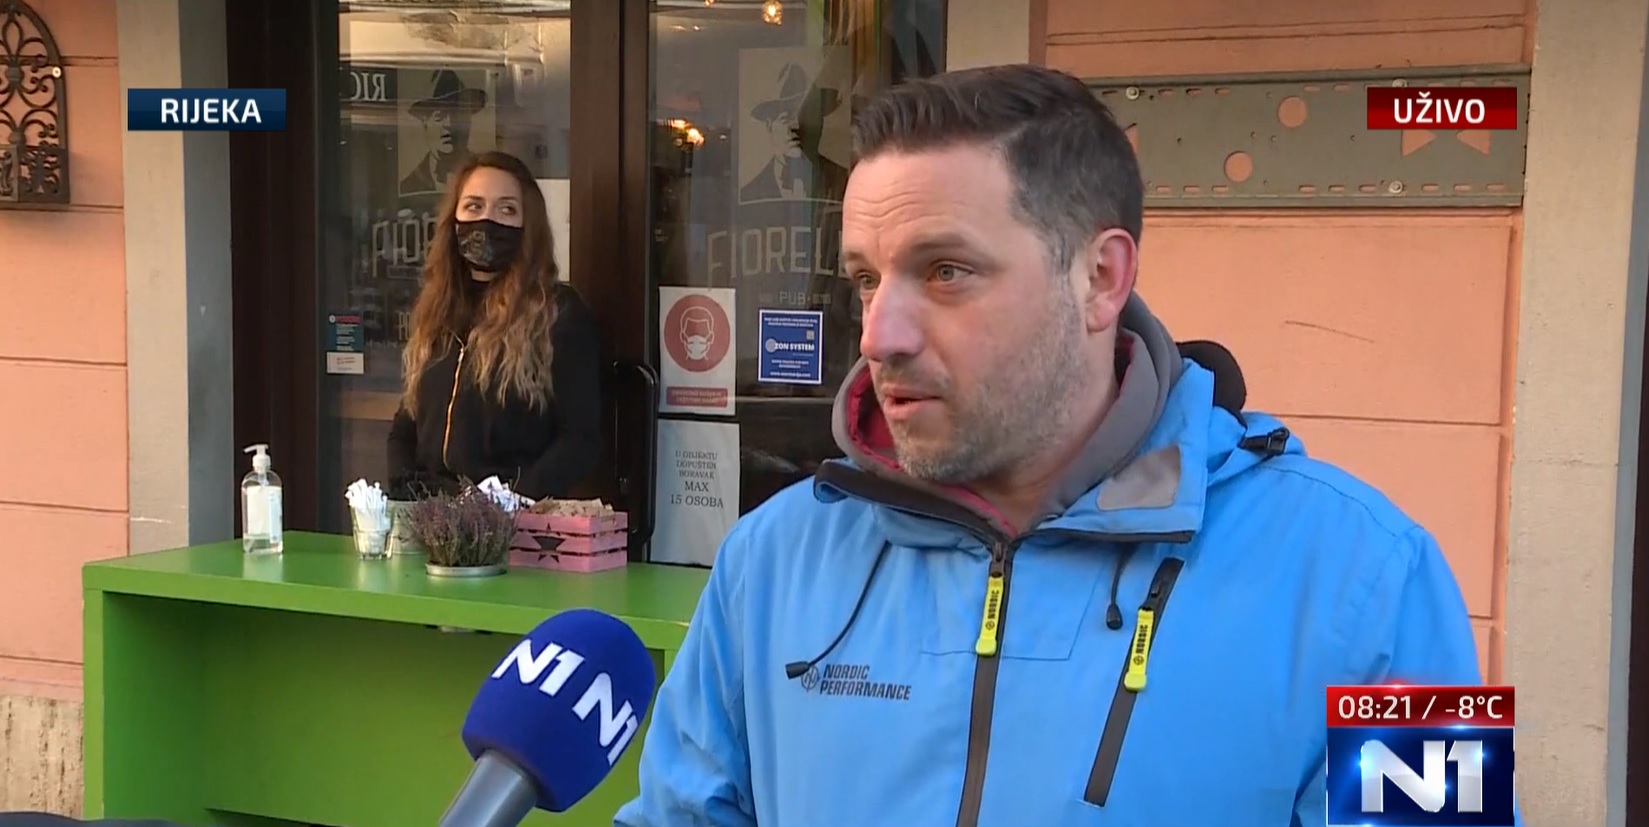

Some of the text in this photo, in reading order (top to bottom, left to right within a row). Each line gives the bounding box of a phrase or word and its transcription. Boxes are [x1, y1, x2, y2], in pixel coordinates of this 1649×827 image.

[789, 342, 815, 351] SYSTEM
[685, 480, 709, 492] MAX
[671, 493, 724, 508] 15 OSOBA
[491, 639, 585, 697] N1
[823, 663, 870, 680] NORDIC
[819, 680, 912, 701] PERFORMANCE
[571, 671, 639, 767] N1
